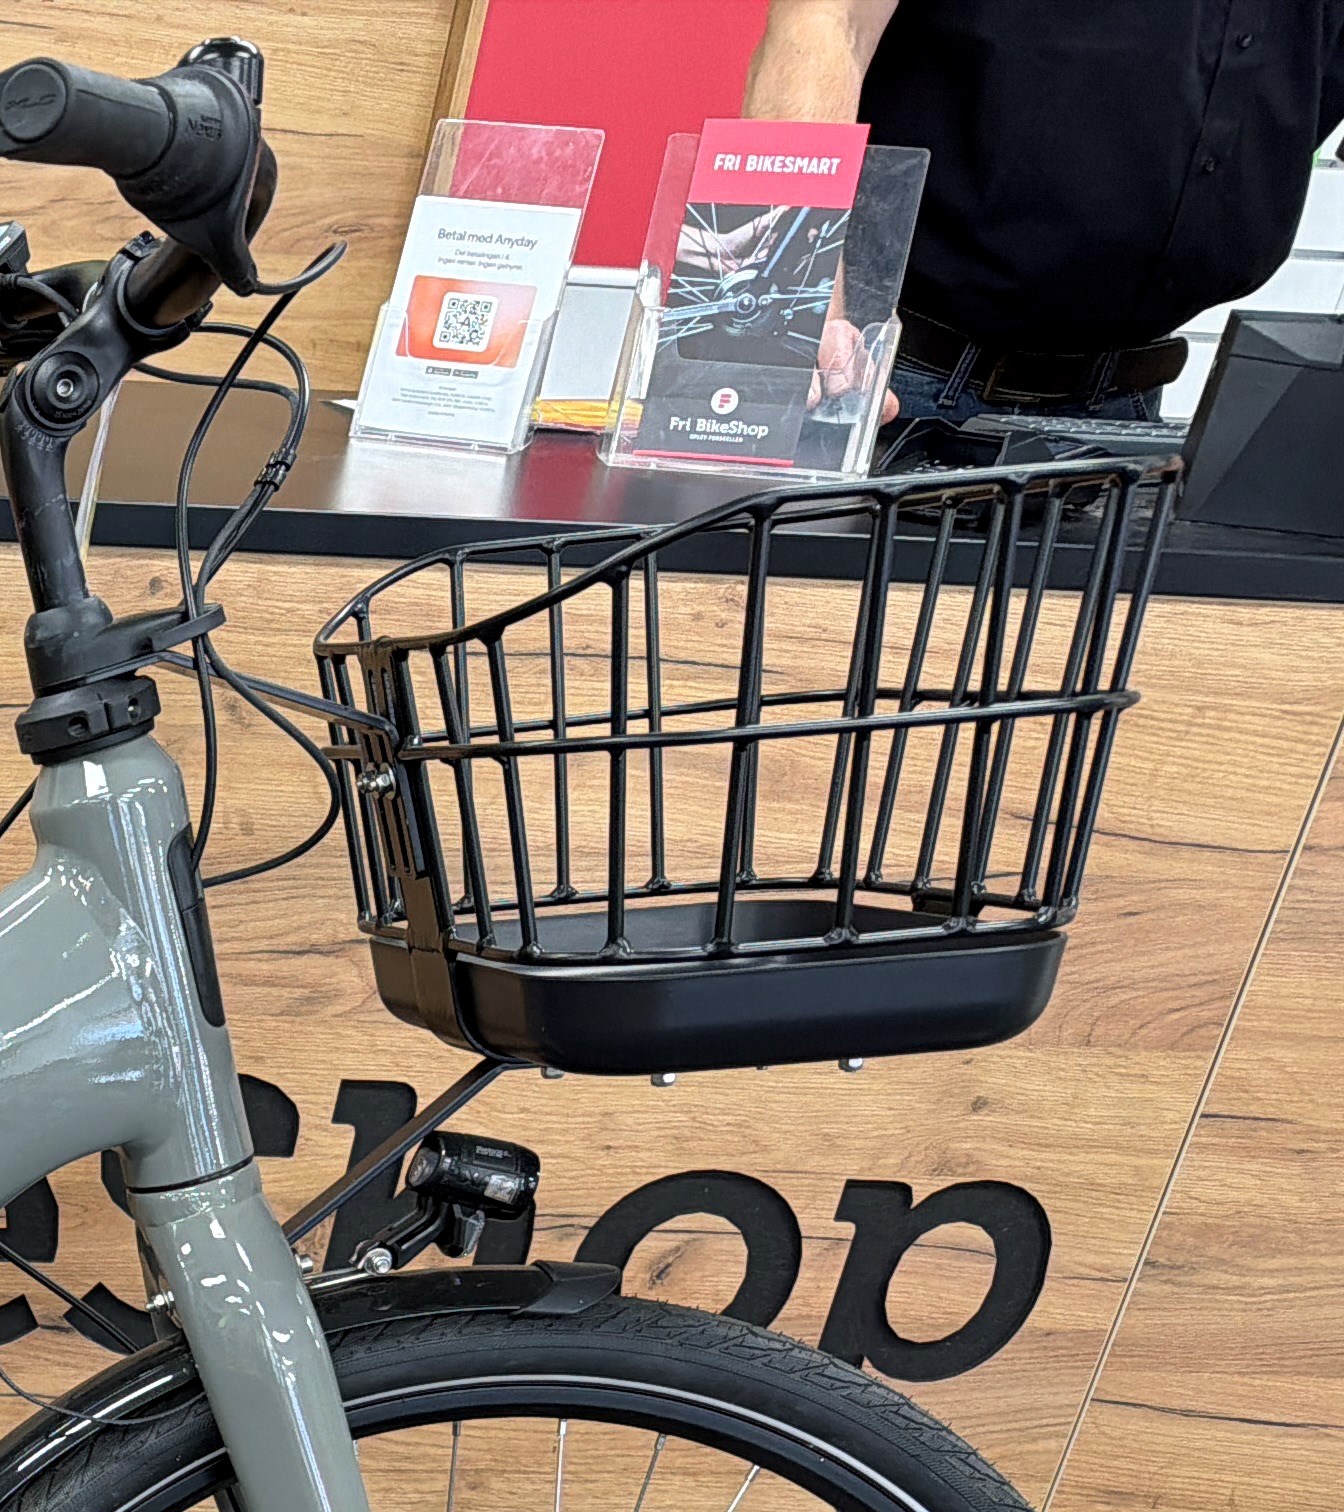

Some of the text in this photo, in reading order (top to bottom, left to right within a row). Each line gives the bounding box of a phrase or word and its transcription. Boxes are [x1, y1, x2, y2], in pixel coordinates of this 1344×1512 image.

[713, 153, 841, 175] FRI BIKESMART
[437, 227, 467, 241] Betal
[494, 234, 538, 250] Anyday
[669, 416, 769, 439] Fri BikeShop
